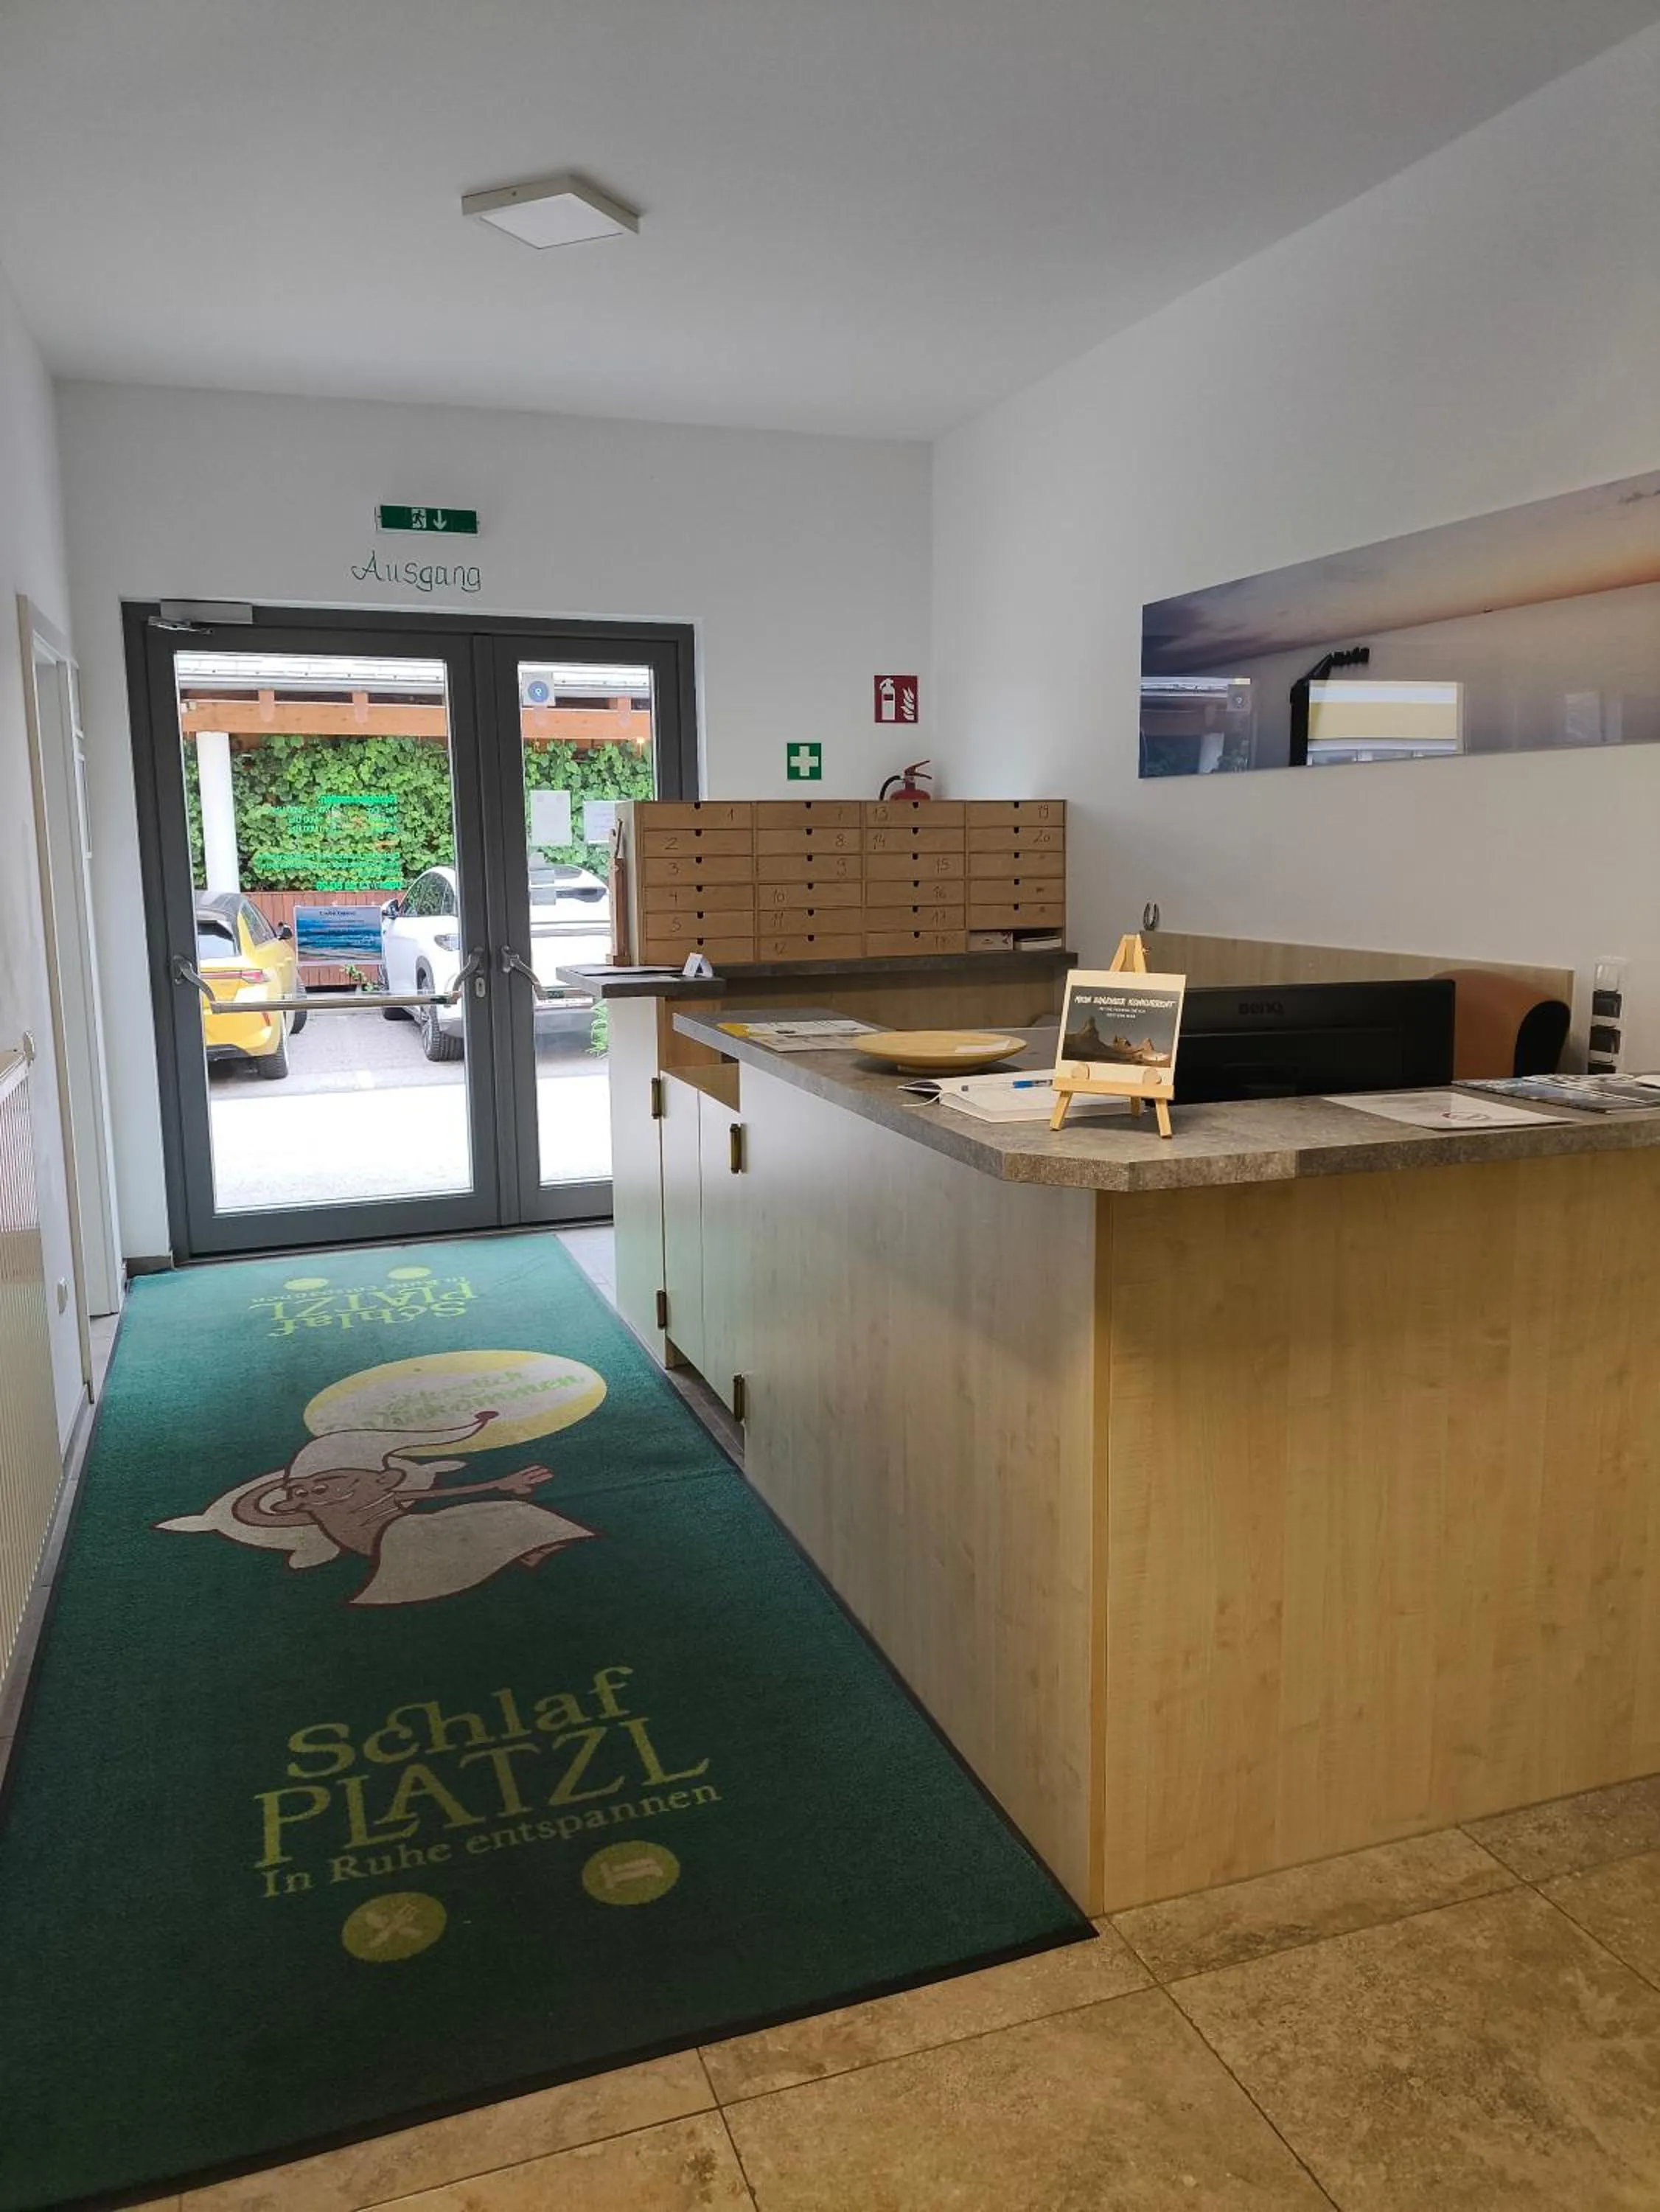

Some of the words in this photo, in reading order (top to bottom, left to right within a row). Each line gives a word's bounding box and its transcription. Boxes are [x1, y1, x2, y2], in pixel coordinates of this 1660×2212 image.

[352, 550, 481, 591] Ausgang
[664, 837, 679, 849] 2
[836, 833, 845, 848] 8
[872, 833, 885, 849] 14
[669, 862, 680, 875] 3
[935, 858, 951, 874] 15
[774, 888, 785, 903] 10
[670, 917, 681, 932] 5
[248, 1280, 478, 1321] PLATZL
[287, 1665, 635, 1778] Schlaf
[254, 1716, 711, 1869] PLATZL
[261, 1868, 313, 1899] In
[329, 1843, 453, 1883] Ruhe
[464, 1784, 723, 1855] entspannen
